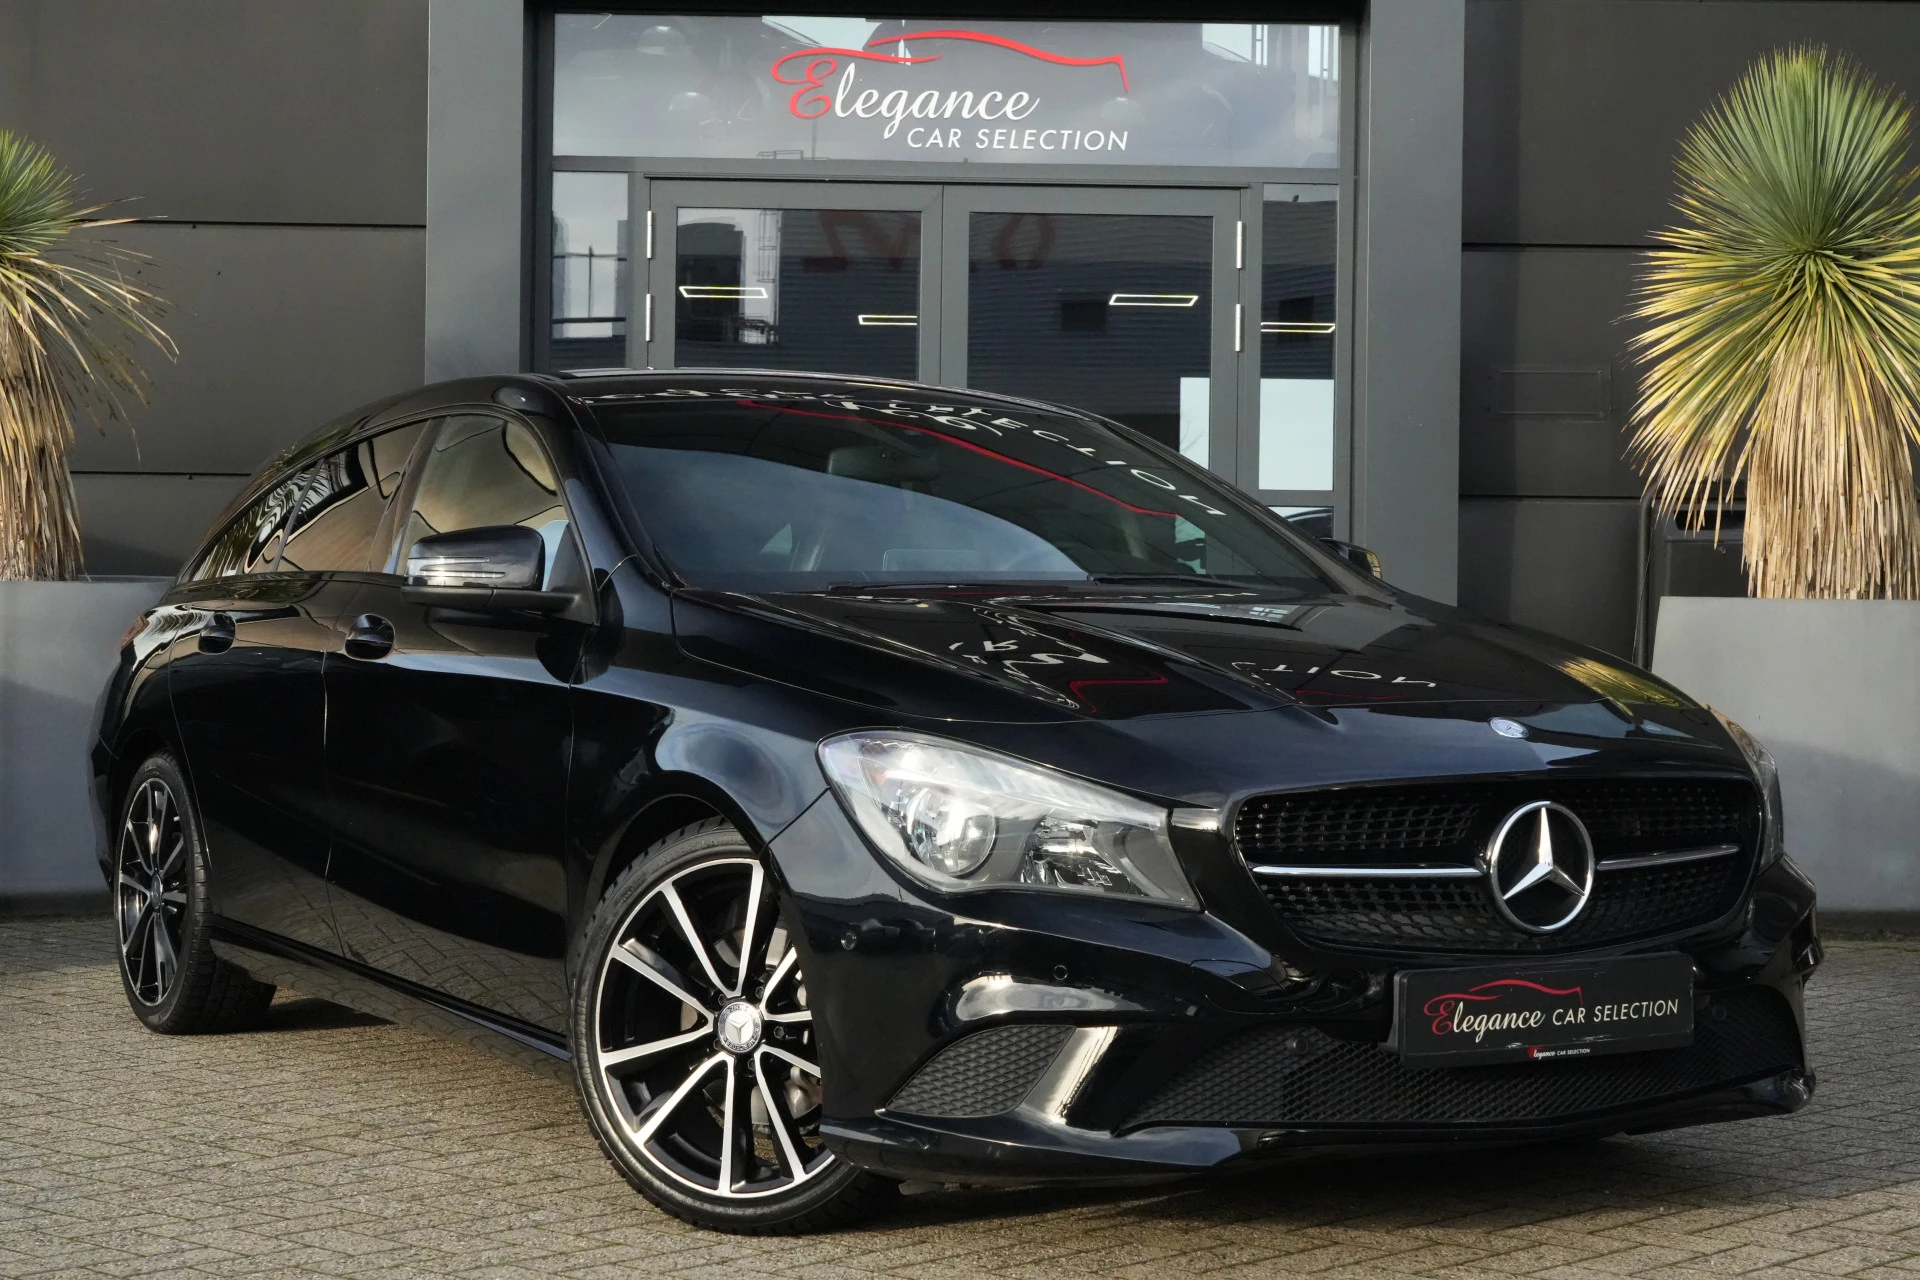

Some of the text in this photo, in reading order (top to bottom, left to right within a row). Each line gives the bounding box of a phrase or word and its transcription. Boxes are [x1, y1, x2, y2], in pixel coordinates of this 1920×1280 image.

[771, 56, 1040, 140] Elegance
[906, 127, 1129, 152] CAR SELECTION
[1424, 998, 1680, 1043] Elegance CAR SELECTION
